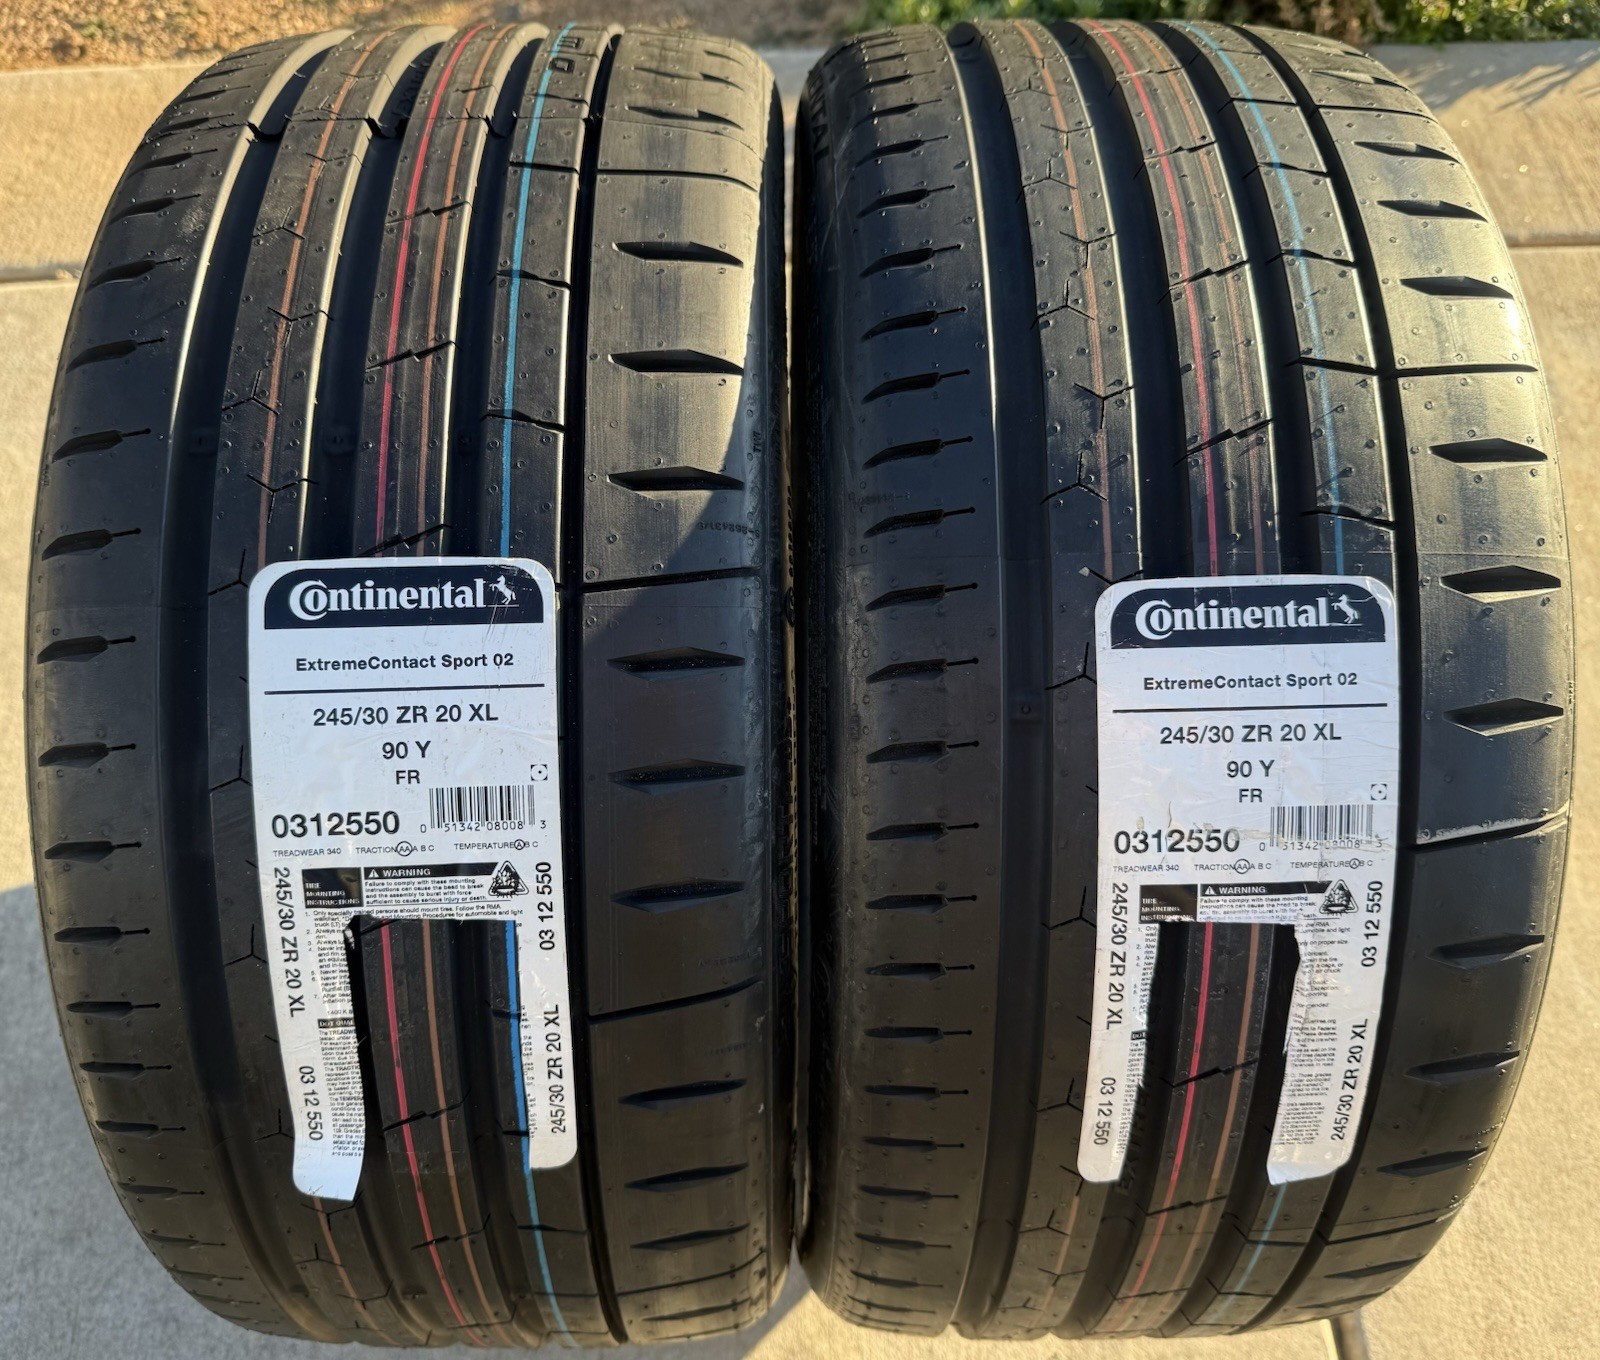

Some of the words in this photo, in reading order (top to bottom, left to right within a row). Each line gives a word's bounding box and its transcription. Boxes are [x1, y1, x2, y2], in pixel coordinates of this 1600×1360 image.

[289, 578, 486, 621] Continental
[1136, 597, 1330, 640] Continental
[296, 655, 436, 671] ExtremeContact
[442, 654, 487, 669] Sport
[493, 653, 514, 667] 02
[1144, 675, 1281, 691] ExtremeContact
[1286, 674, 1332, 689] Sport
[1337, 673, 1357, 686] 02
[313, 707, 388, 726] 245/30
[396, 706, 428, 724] ZR
[436, 705, 461, 722] 20
[469, 704, 499, 721] XL
[1160, 725, 1234, 744] 245/30
[1242, 724, 1272, 742] ZR
[1280, 724, 1306, 741] 20
[1313, 723, 1342, 741] XL
[382, 743, 408, 759] 90
[415, 741, 431, 758] Y
[395, 770, 420, 784] FR
[1227, 761, 1252, 778] 90
[1259, 760, 1275, 777] Y
[1239, 789, 1263, 803] FR
[272, 811, 400, 838] 0312550
[420, 824, 427, 833] 0
[444, 821, 481, 833] 51342
[486, 821, 524, 831] 08008
[540, 820, 547, 829] 3
[454, 842, 514, 850] TEMPERATURE
[1114, 828, 1240, 854] 0312550
[1259, 842, 1265, 851] 0
[383, 868, 431, 877] WARNING
[1113, 865, 1163, 873] TREADWEAR
[1290, 861, 1350, 869] TEMPERATURE
[536, 862, 552, 895] 550
[274, 867, 296, 930] 245/30
[306, 890, 345, 898] MOUNTING
[1219, 886, 1266, 894] WARNING
[1366, 880, 1383, 914] 550
[307, 898, 360, 906] INSTRUCTIONS
[537, 901, 553, 923] 12
[313, 910, 326, 918] Only
[328, 910, 353, 918] specially
[376, 908, 398, 916] persons
[1111, 882, 1128, 946] 245/30
[539, 929, 555, 950] 03
[1364, 919, 1379, 940] 12
[281, 936, 299, 962] ZR
[1361, 946, 1377, 968] 03
[1109, 951, 1126, 976] ZR
[285, 969, 302, 989] 20
[1108, 983, 1124, 1003] 20
[288, 994, 305, 1017] XL
[544, 1004, 559, 1027] XL
[1106, 1008, 1123, 1030] XL
[1351, 1018, 1368, 1040] XL
[546, 1032, 561, 1053] 20
[1348, 1045, 1363, 1063] 20
[299, 1066, 316, 1084] 03
[547, 1057, 563, 1080] ZR
[1342, 1068, 1359, 1090] ZR
[1100, 1077, 1116, 1095] 03
[303, 1090, 320, 1107] 12
[549, 1084, 566, 1134] 245/30
[1098, 1100, 1113, 1117] 12
[307, 1111, 323, 1141] 550
[1331, 1095, 1353, 1141] 245/30
[1094, 1121, 1111, 1146] 550
